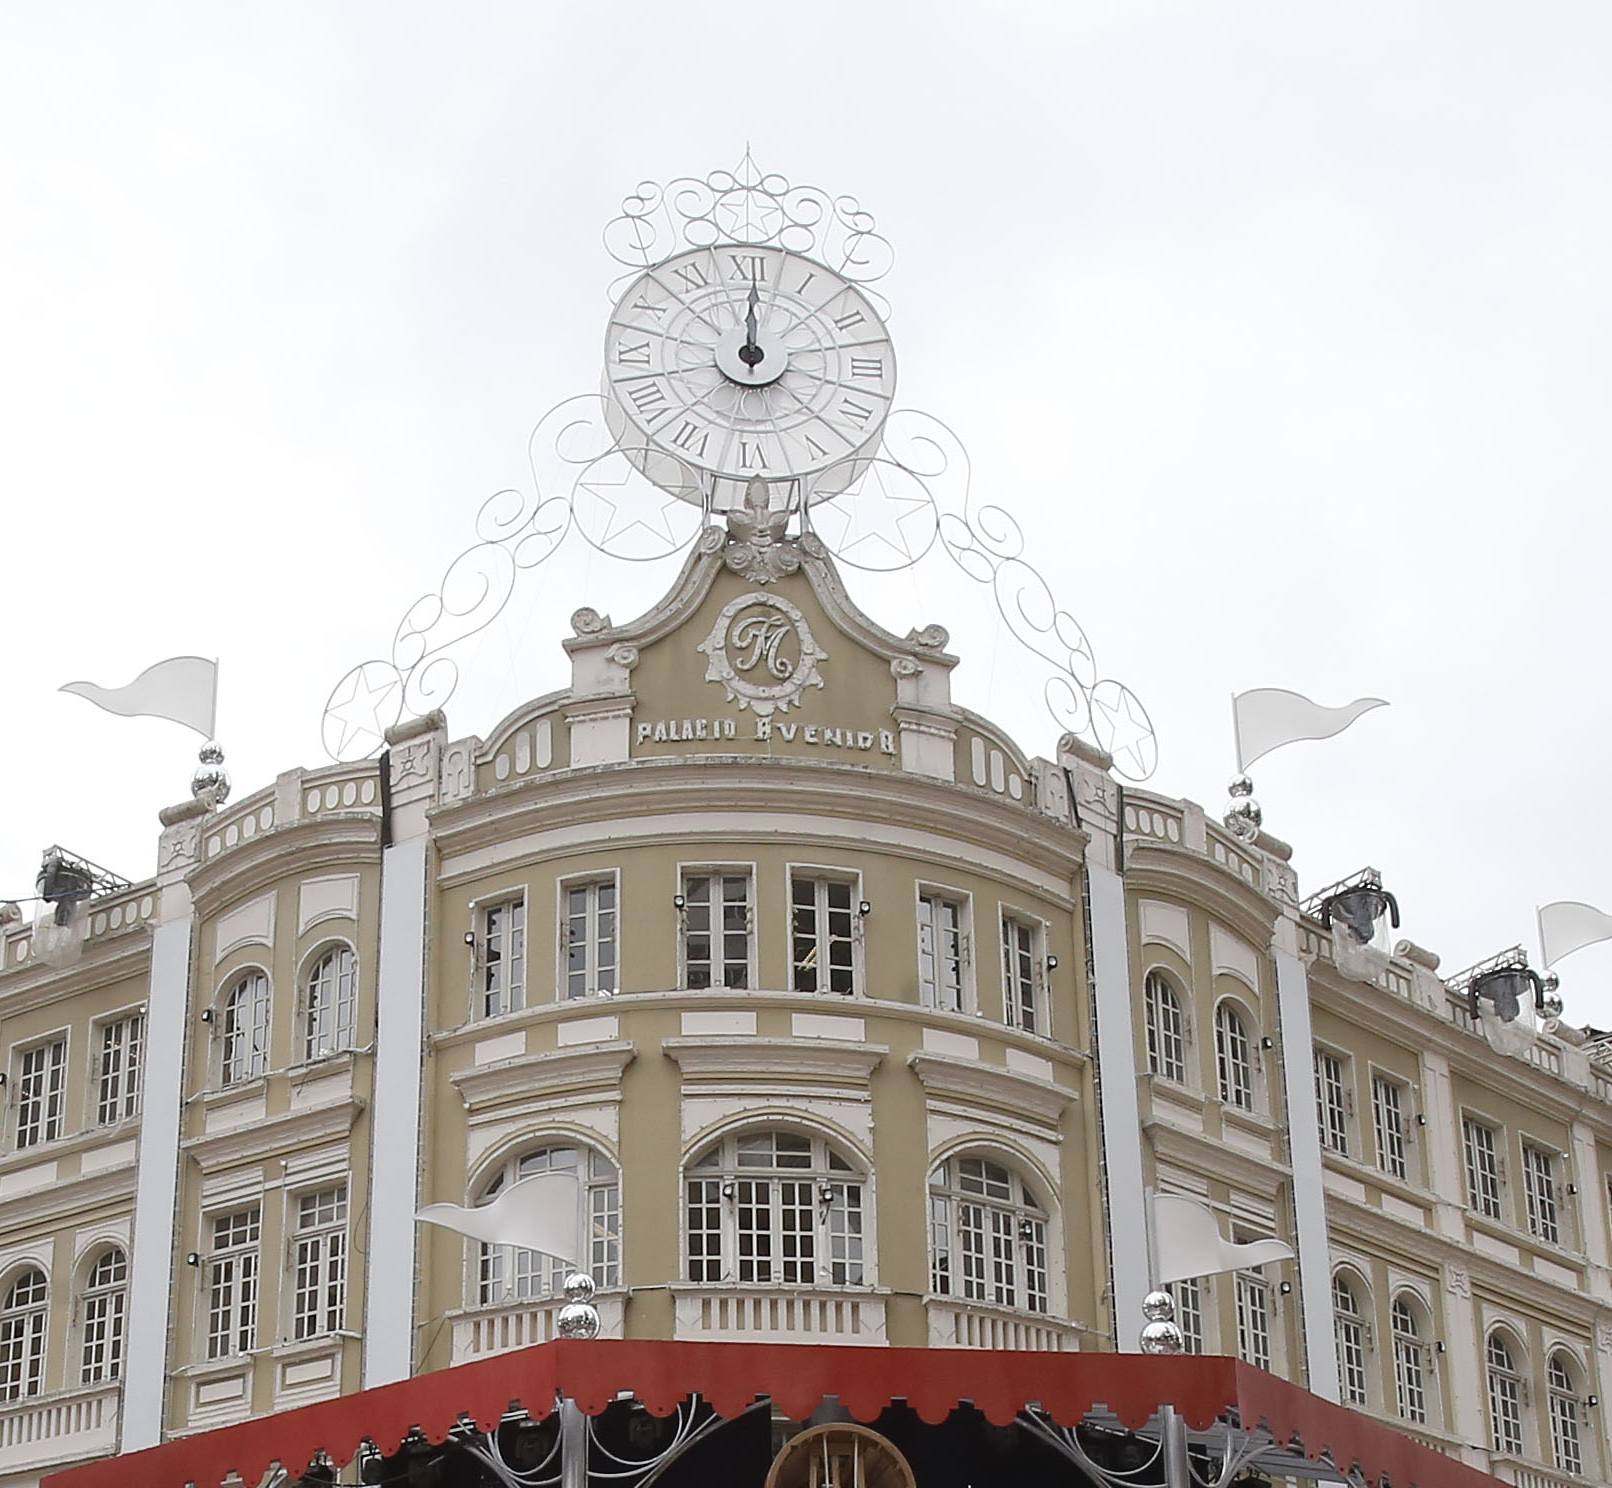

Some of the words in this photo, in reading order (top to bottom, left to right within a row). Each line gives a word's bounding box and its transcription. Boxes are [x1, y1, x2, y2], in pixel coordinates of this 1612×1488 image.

[673, 262, 710, 293] XI
[729, 255, 767, 281] XII
[796, 272, 817, 296] I
[631, 295, 668, 321] X
[833, 310, 868, 331] II
[618, 341, 651, 366] IX
[851, 357, 883, 379] III
[628, 380, 672, 425] VIII
[839, 397, 874, 430] IV
[671, 420, 710, 459] VII
[804, 433, 830, 461] V
[740, 441, 770, 469] VI
[754, 716, 897, 755] AVENIDA
